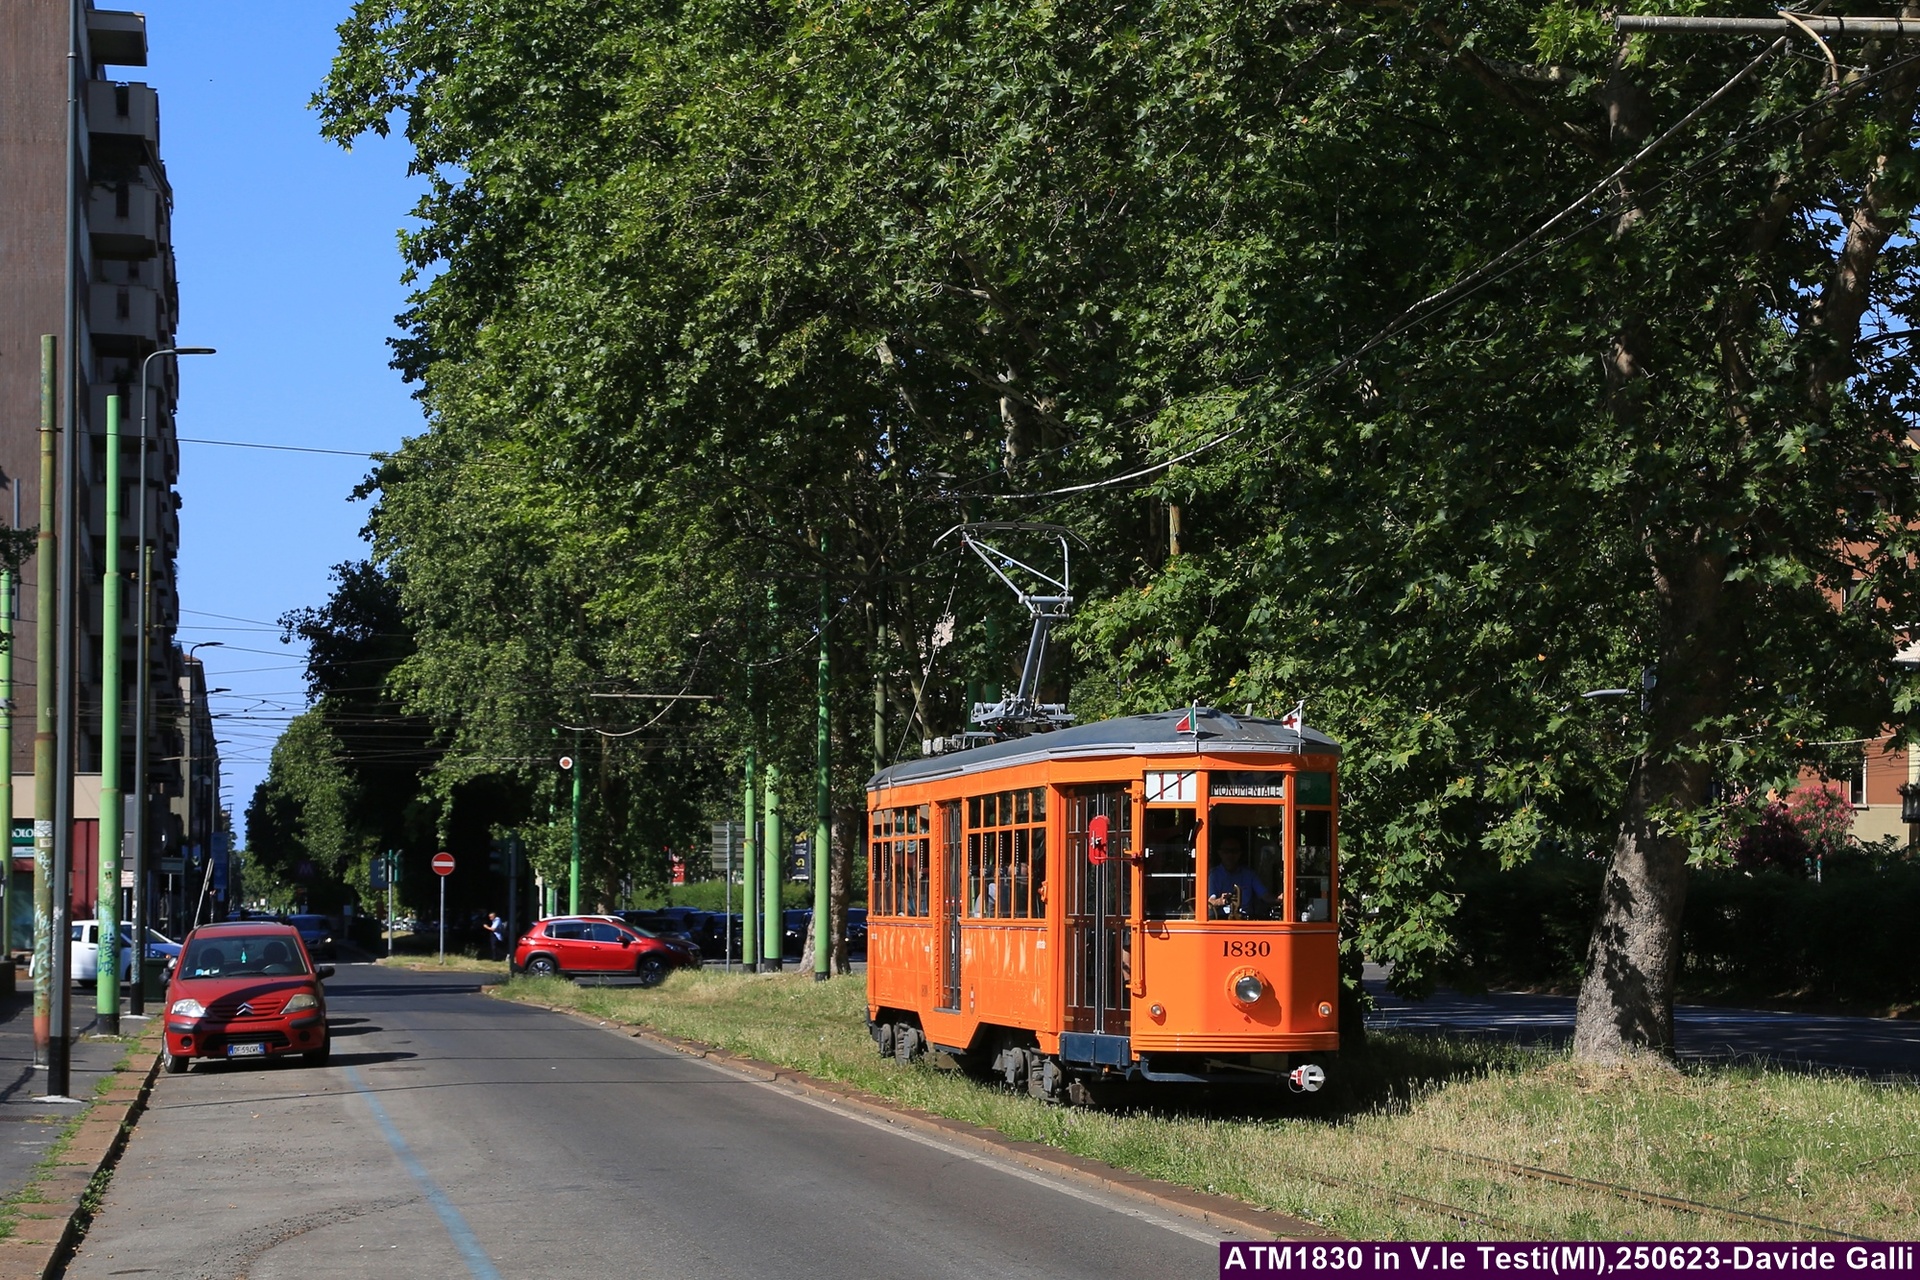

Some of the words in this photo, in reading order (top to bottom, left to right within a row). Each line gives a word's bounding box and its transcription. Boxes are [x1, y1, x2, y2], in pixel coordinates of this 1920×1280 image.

[1159, 772, 1182, 800] 11
[1212, 785, 1283, 797] MONUMENTALE
[12, 828, 34, 838] OLO
[1223, 940, 1271, 957] 1830
